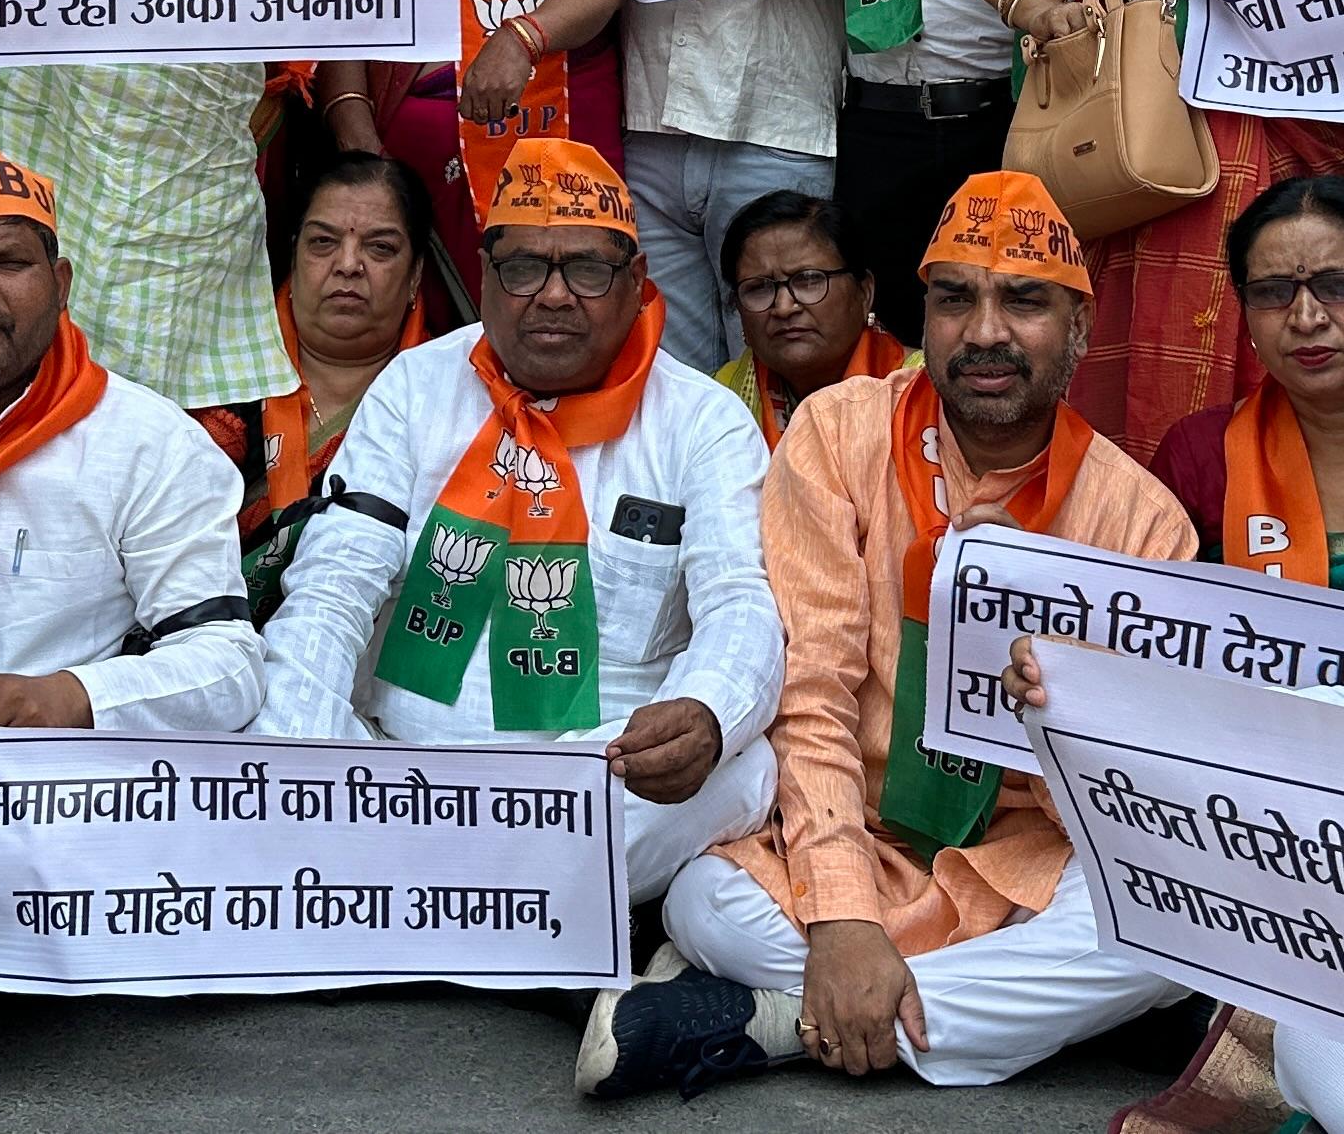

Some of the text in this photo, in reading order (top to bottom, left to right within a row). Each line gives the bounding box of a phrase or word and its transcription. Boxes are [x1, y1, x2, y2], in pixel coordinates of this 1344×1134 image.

[1217, 52, 1339, 97] आजम
[406, 605, 464, 646] BJP
[956, 564, 1093, 642] जिसने
[1107, 591, 1211, 668] दिया
[1223, 613, 1305, 687] देश
[190, 762, 269, 821] पार्टी
[279, 779, 335, 821] का
[345, 766, 480, 827] घिनौना
[489, 787, 592, 836] काम।
[1079, 769, 1206, 851] दलित
[13, 867, 562, 939] बाबा साहेब का किया अपमान,
